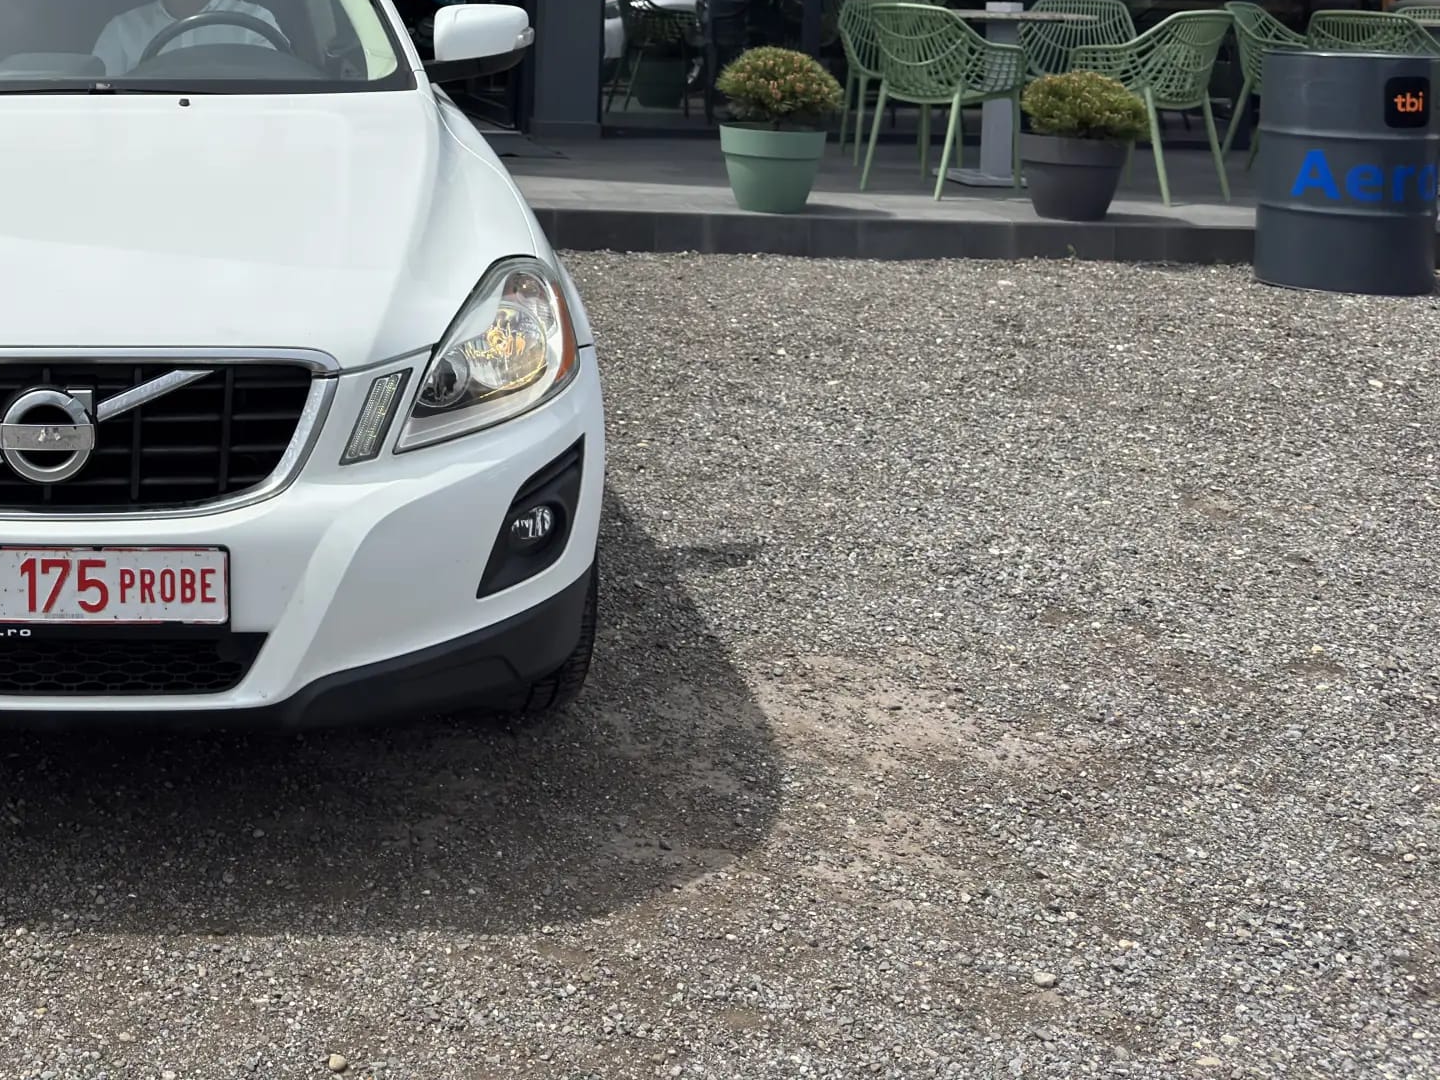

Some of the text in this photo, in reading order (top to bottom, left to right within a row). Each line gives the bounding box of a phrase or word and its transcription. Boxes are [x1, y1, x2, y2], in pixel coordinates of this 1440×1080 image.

[1394, 91, 1424, 112] tbi
[19, 557, 110, 614] 175
[119, 567, 217, 604] PROBE
